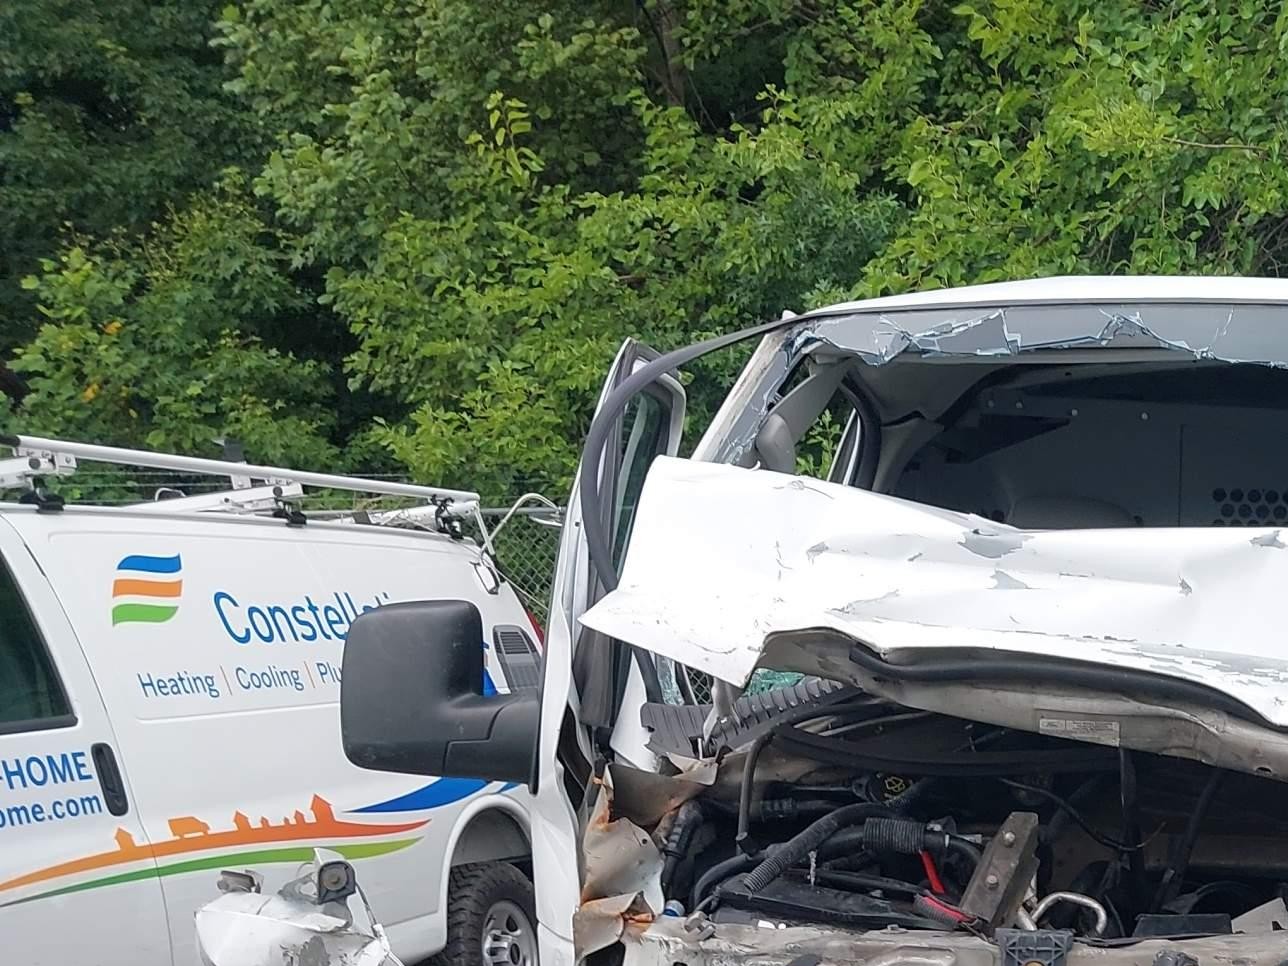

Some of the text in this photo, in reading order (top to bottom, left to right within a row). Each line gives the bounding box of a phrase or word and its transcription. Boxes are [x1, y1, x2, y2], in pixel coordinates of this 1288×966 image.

[213, 591, 389, 644] Constell
[137, 671, 220, 698] Heating
[235, 665, 305, 692] Cooling
